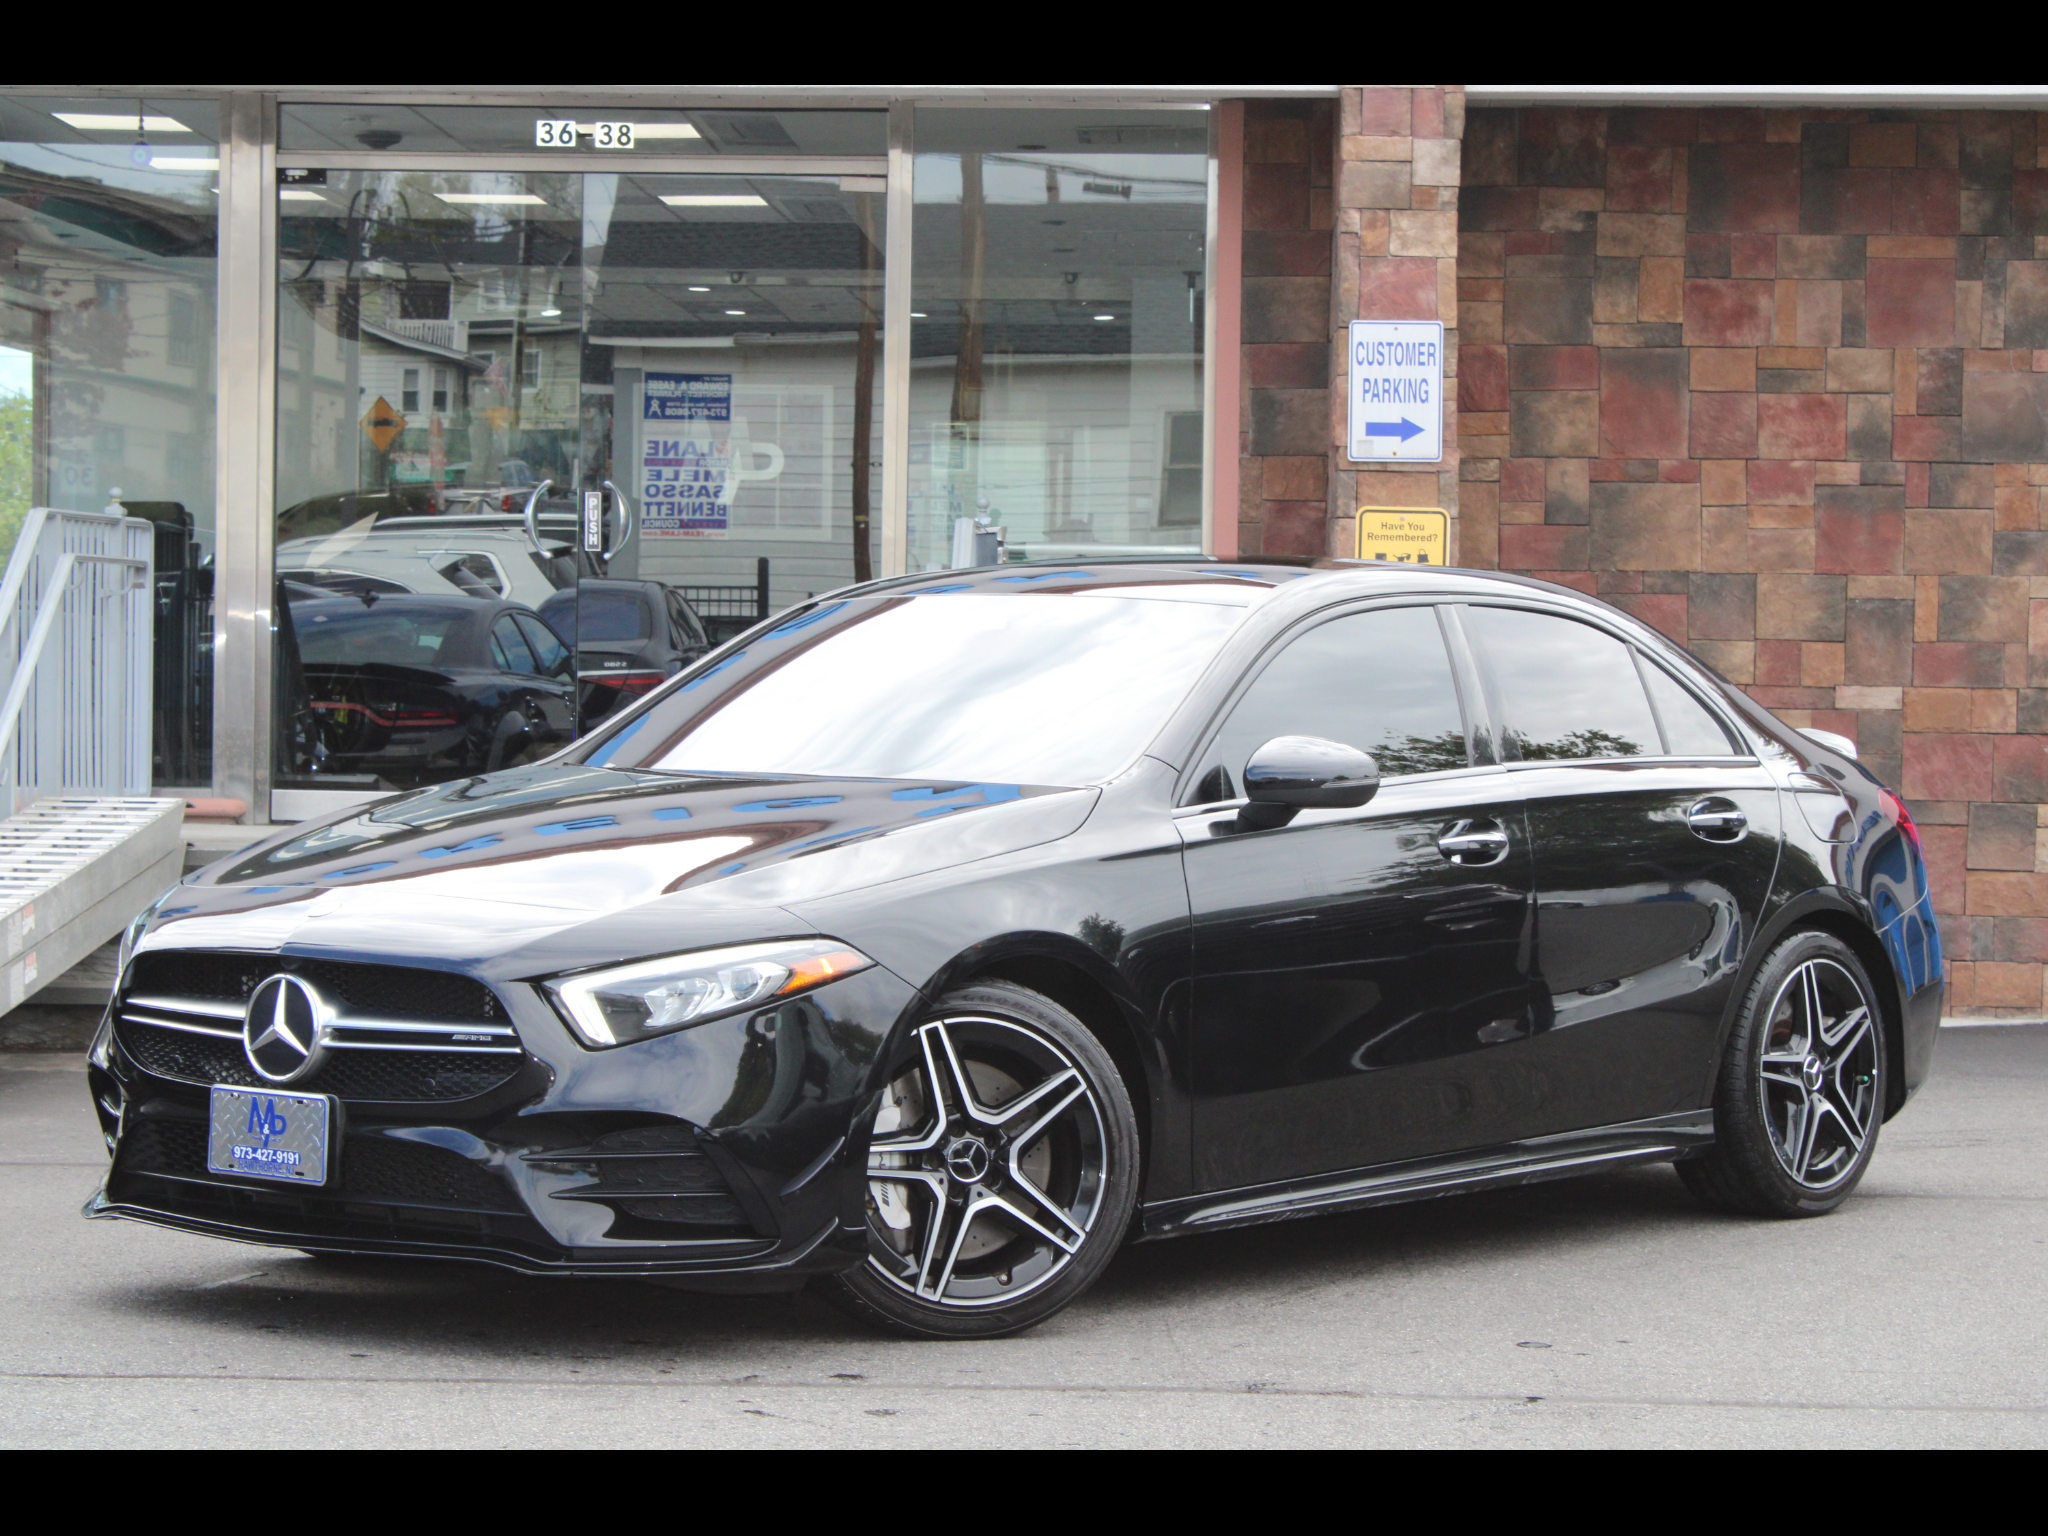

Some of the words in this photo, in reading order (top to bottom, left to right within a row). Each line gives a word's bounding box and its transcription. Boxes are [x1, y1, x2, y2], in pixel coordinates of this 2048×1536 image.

[1355, 341, 1437, 367] CUSTOMER
[1362, 377, 1429, 404] PARKING
[588, 497, 598, 546] PUSH
[1381, 521, 1405, 531] Have
[1407, 522, 1425, 531] You
[1367, 532, 1438, 543] Remembered?
[233, 1145, 300, 1166] 973-427-9191
